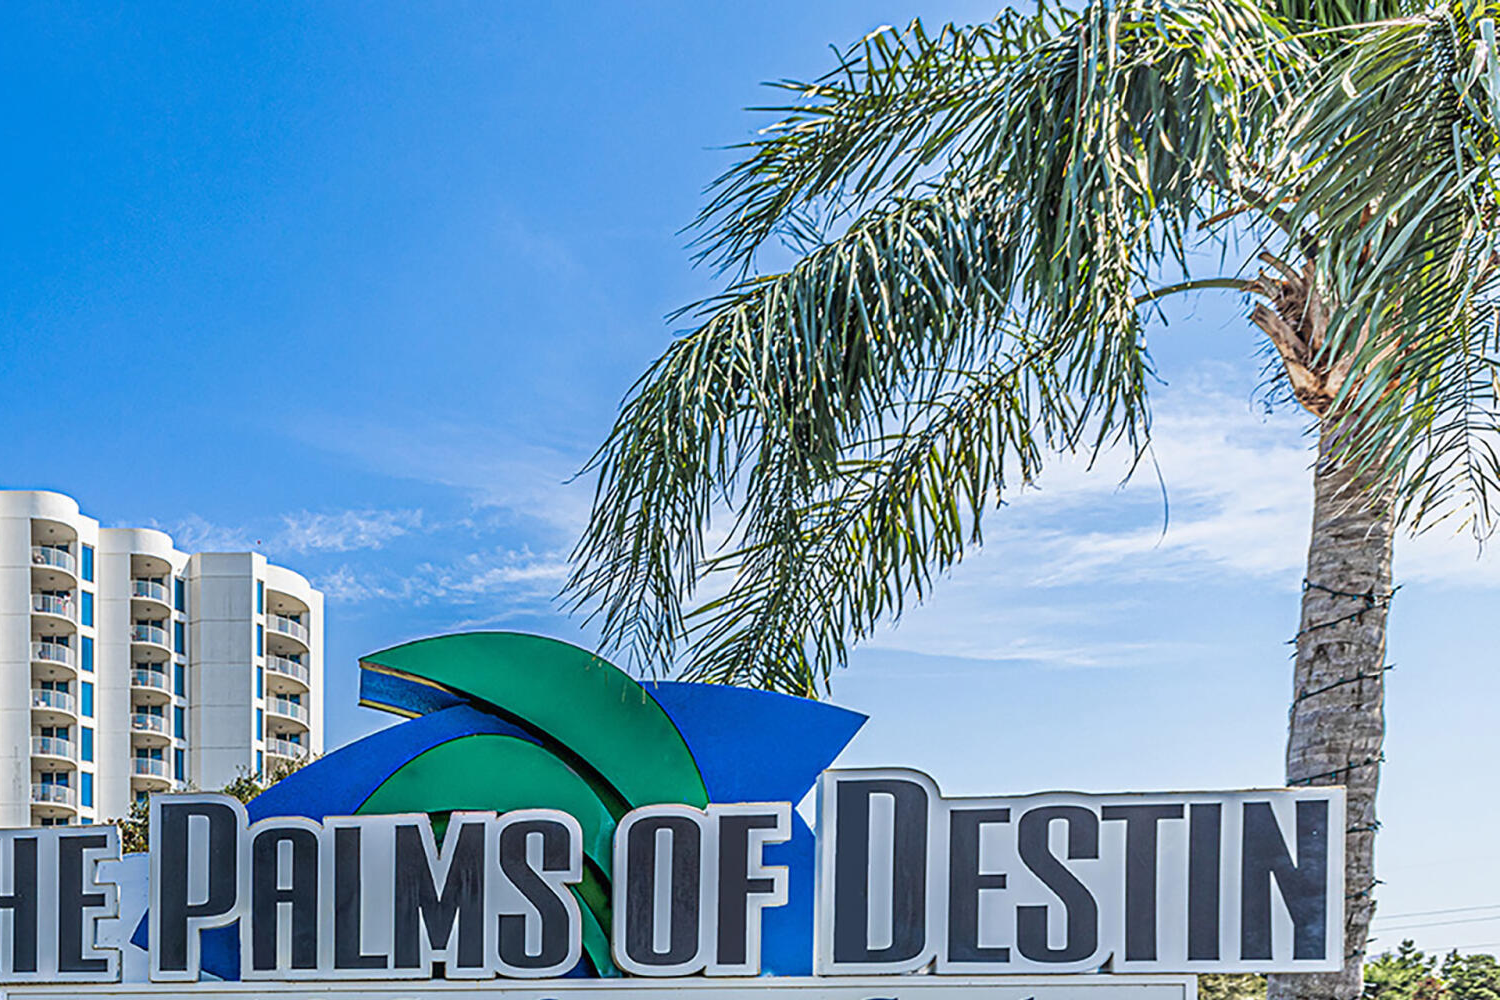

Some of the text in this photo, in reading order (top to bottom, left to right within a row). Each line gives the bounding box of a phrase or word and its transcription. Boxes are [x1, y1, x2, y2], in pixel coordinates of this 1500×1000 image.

[159, 802, 572, 971] PALMS
[626, 814, 778, 965] OF
[834, 780, 1330, 963] DESTIN
